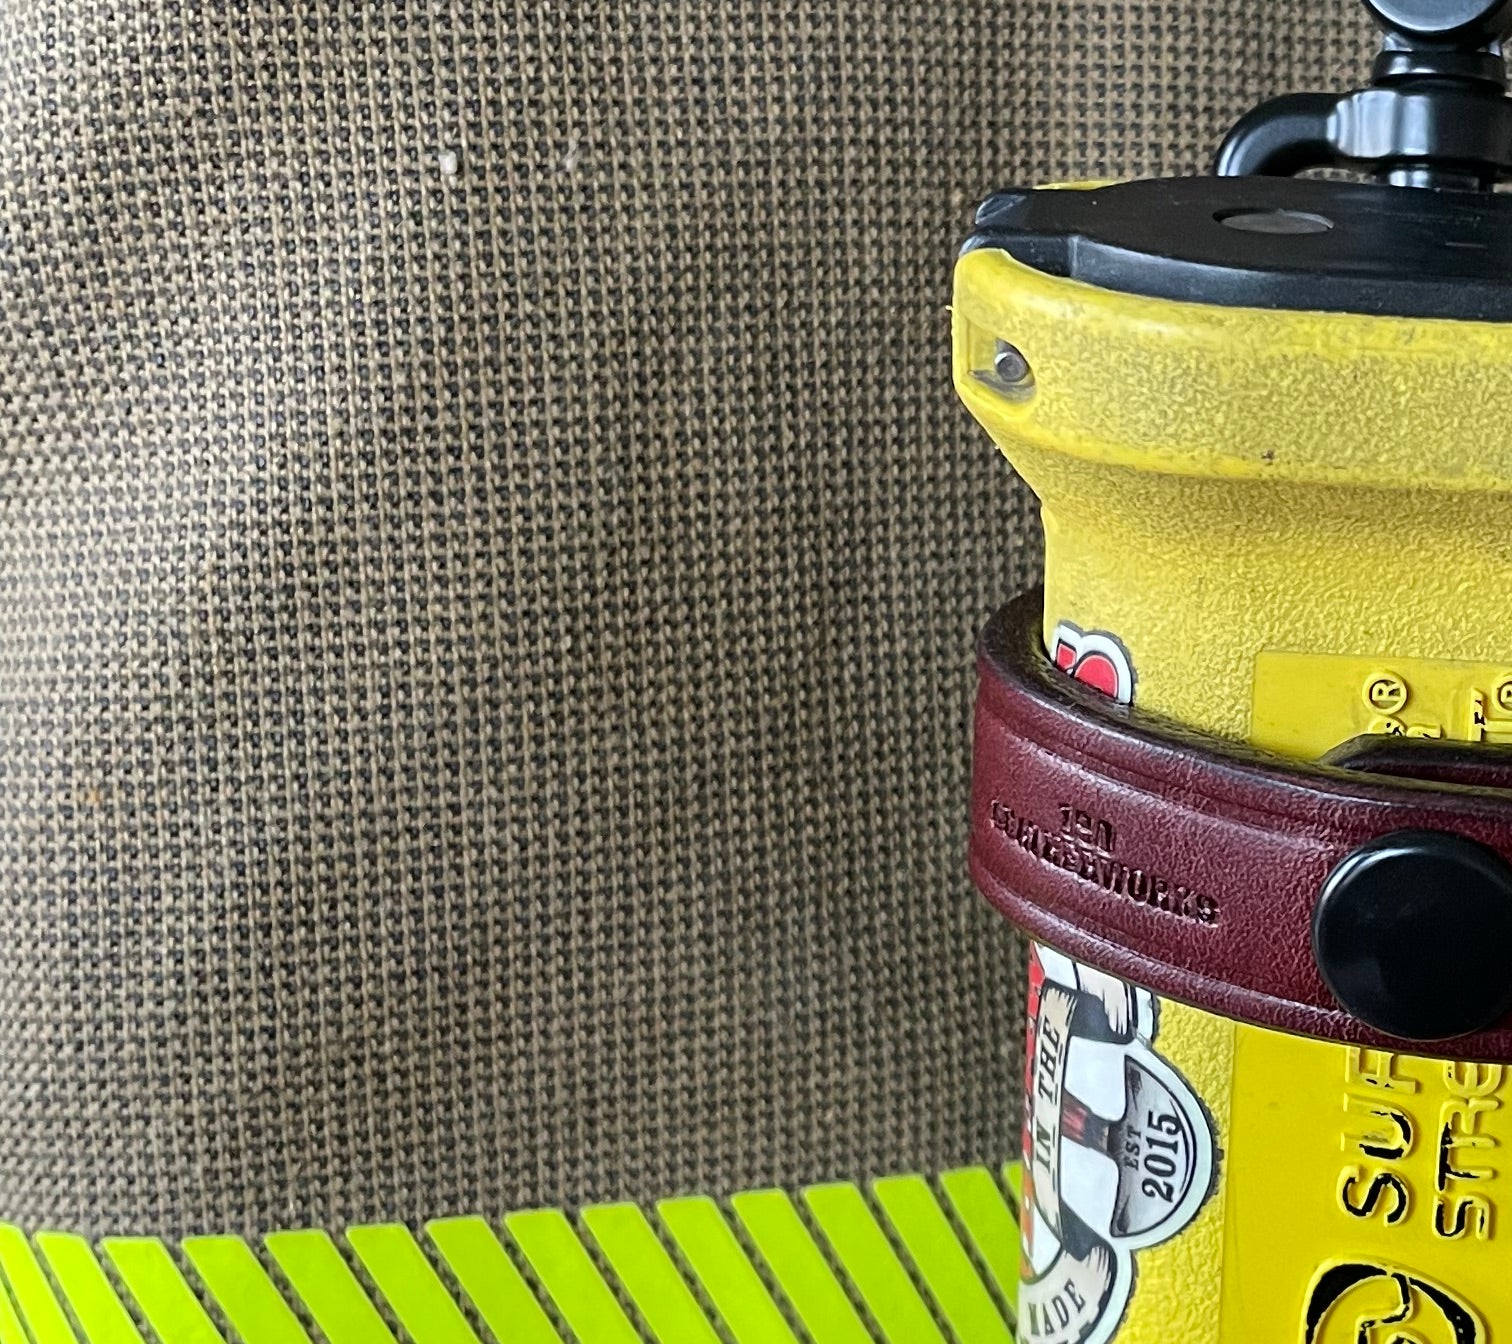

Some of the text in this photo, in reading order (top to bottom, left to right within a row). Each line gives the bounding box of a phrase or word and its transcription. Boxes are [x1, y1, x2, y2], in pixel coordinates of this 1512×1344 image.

[1038, 1017, 1061, 1101] THE
[1035, 1119, 1052, 1174] IN
[1124, 1125, 1142, 1171] EST
[1141, 1110, 1184, 1204] 2015
